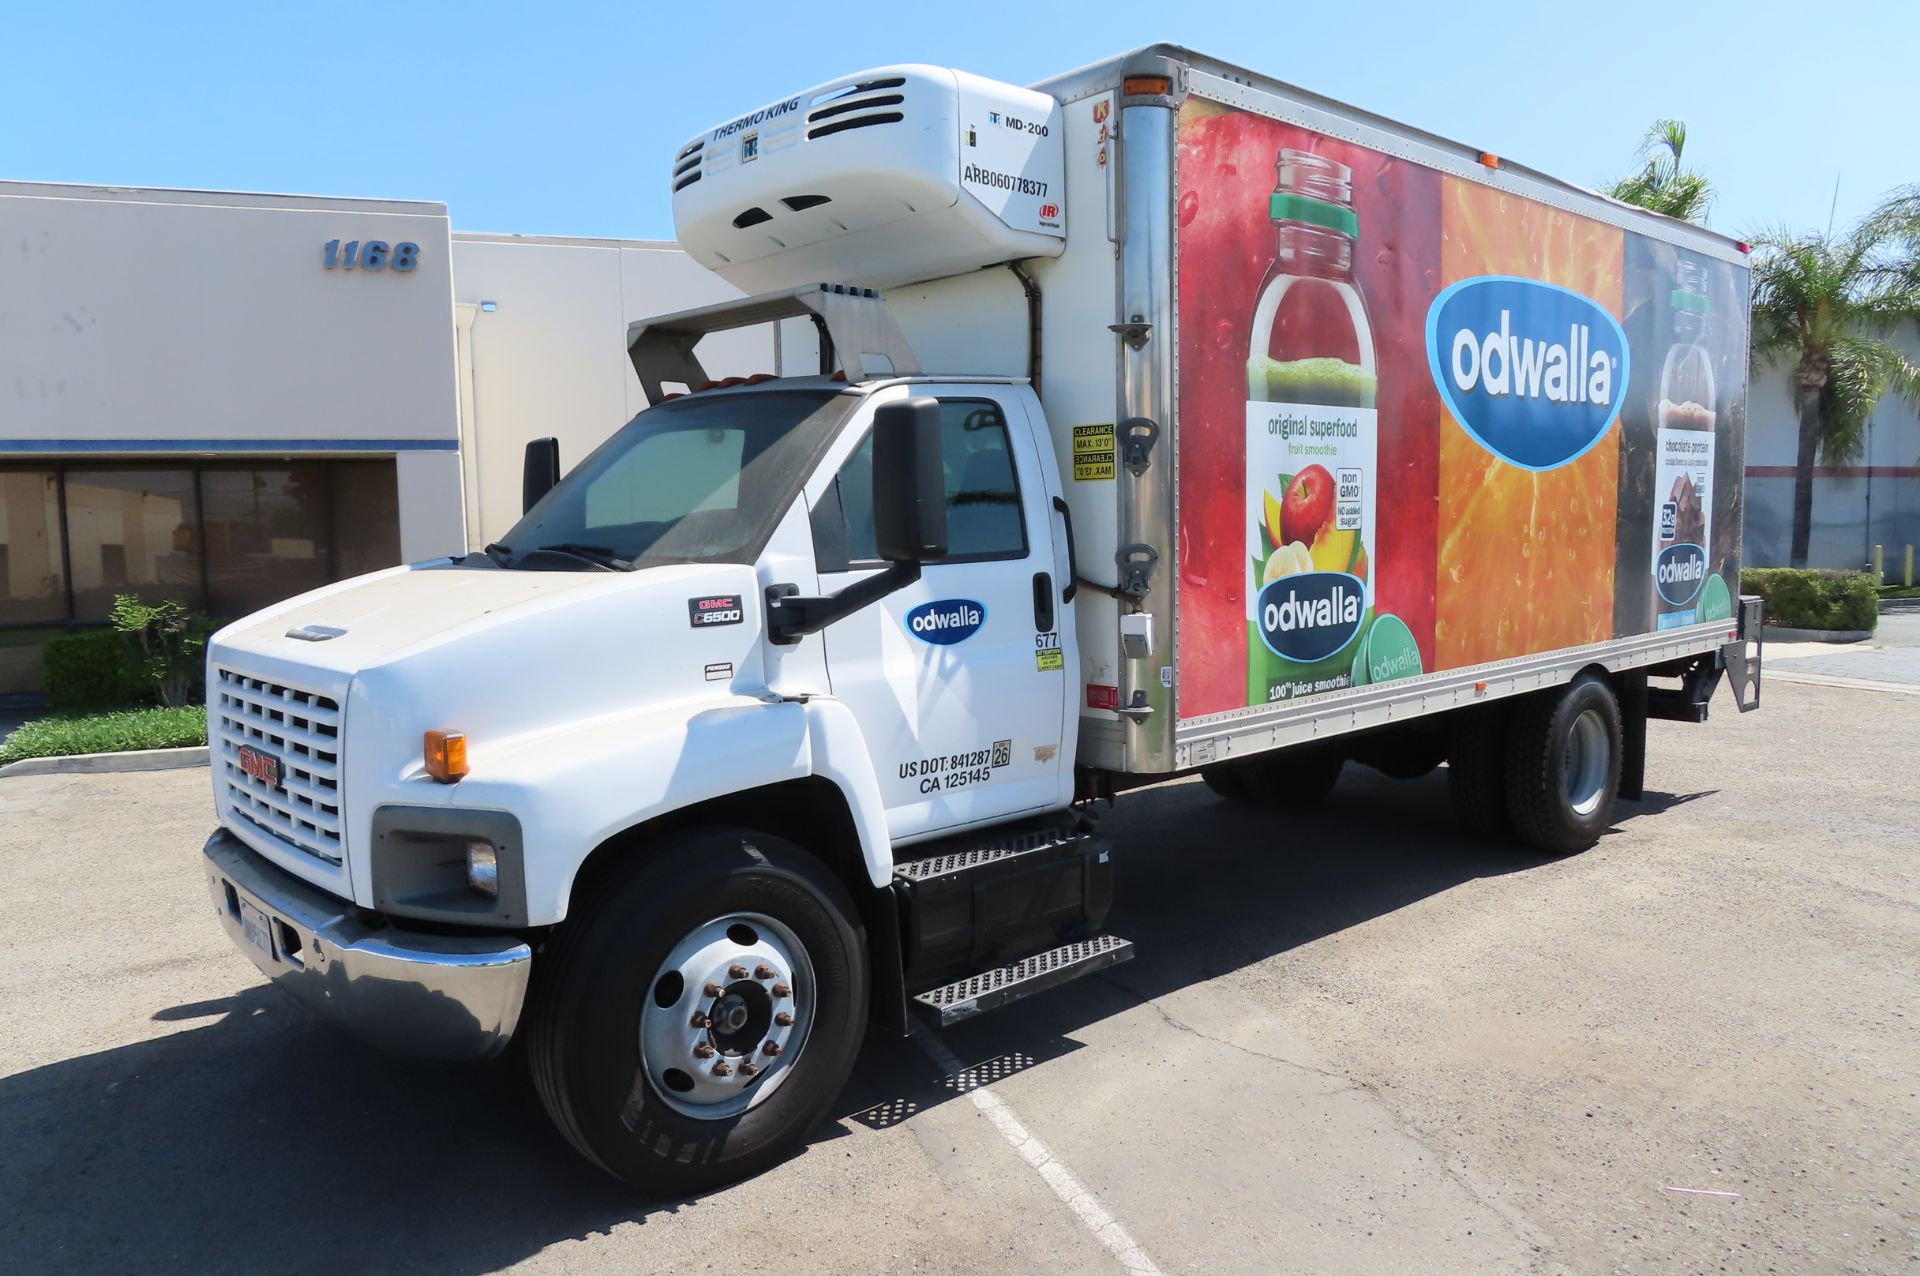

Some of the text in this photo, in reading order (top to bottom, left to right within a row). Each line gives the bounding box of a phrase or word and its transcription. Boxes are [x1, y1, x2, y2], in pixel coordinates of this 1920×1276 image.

[713, 96, 801, 141] THERMO KING
[1006, 116, 1049, 137] MD-200
[964, 165, 1048, 198] ARB060778377
[1041, 204, 1056, 218] IR
[323, 239, 420, 272] 1168
[1074, 425, 1113, 436] CLEARANCE
[1268, 413, 1358, 441] original superfood
[1077, 439, 1093, 449] MAX.
[1288, 443, 1337, 456] fruit smoothie
[1342, 473, 1357, 483] non
[1340, 485, 1359, 498] GMO
[1337, 506, 1361, 516] NO added
[1340, 517, 1358, 527] sugar
[1659, 553, 1702, 584] odwalla
[699, 598, 733, 609] GMC
[1264, 586, 1358, 633] odwalla
[694, 609, 741, 624] C6500
[912, 605, 980, 632] odwalla
[1035, 632, 1057, 648] 677
[1373, 647, 1419, 681] odwalla
[240, 746, 277, 785] GMC
[899, 749, 991, 779] US DOT: 841287
[994, 747, 1009, 765] 26
[919, 767, 991, 794] CA 125145
